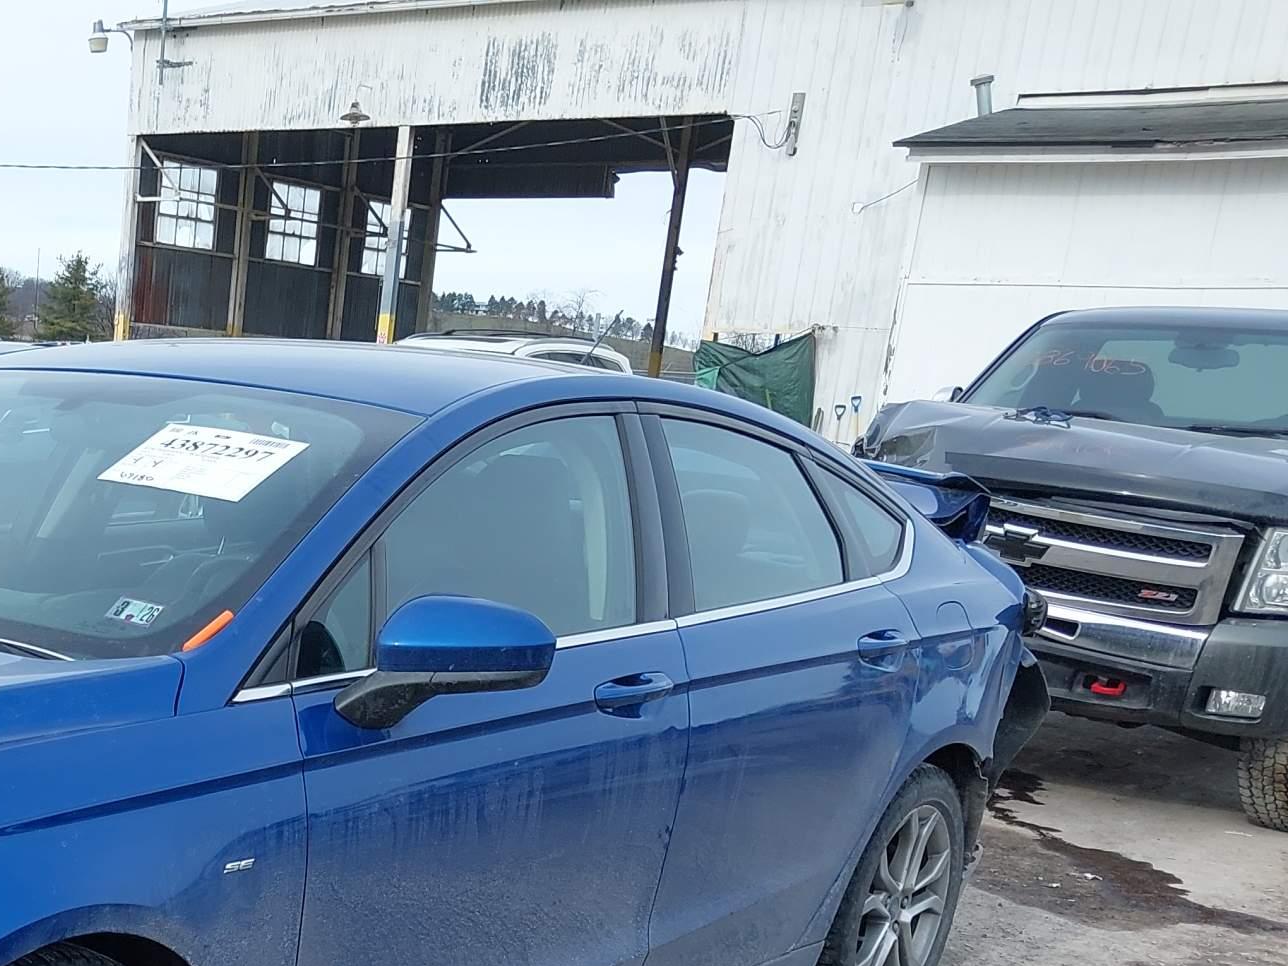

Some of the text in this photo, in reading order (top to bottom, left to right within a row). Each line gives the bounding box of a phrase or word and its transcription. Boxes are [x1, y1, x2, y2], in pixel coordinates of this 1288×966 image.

[160, 438, 276, 462] 43872297
[113, 600, 130, 617] 3
[223, 858, 256, 874] SE
